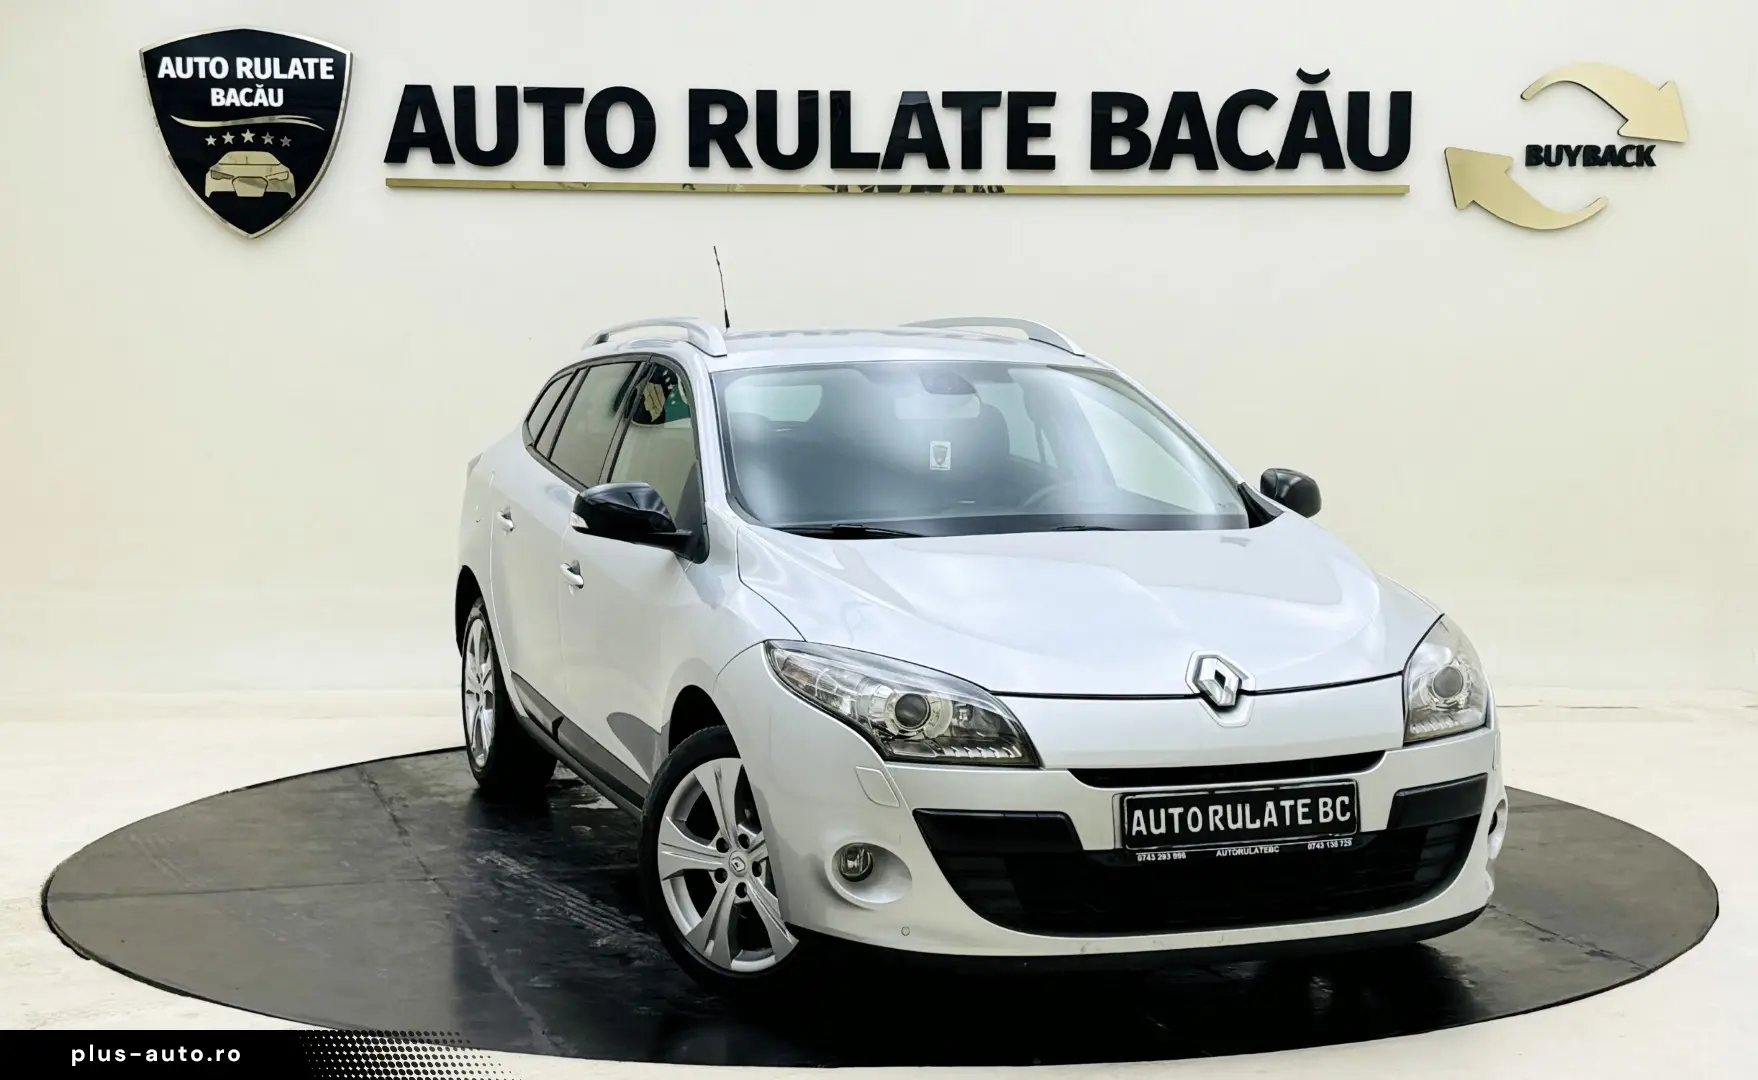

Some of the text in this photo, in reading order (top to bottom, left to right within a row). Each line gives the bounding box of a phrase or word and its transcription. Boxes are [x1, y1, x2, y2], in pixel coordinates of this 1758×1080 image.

[157, 56, 335, 80] AUTO RULATE
[210, 83, 284, 108] BACĂU
[383, 67, 1413, 173] AUTO RULATE BACĂU
[1524, 143, 1657, 168] BUYBACK
[1131, 796, 1351, 837] AUTO RULATE BC
[1215, 846, 1280, 857] AUTORULATEBC
